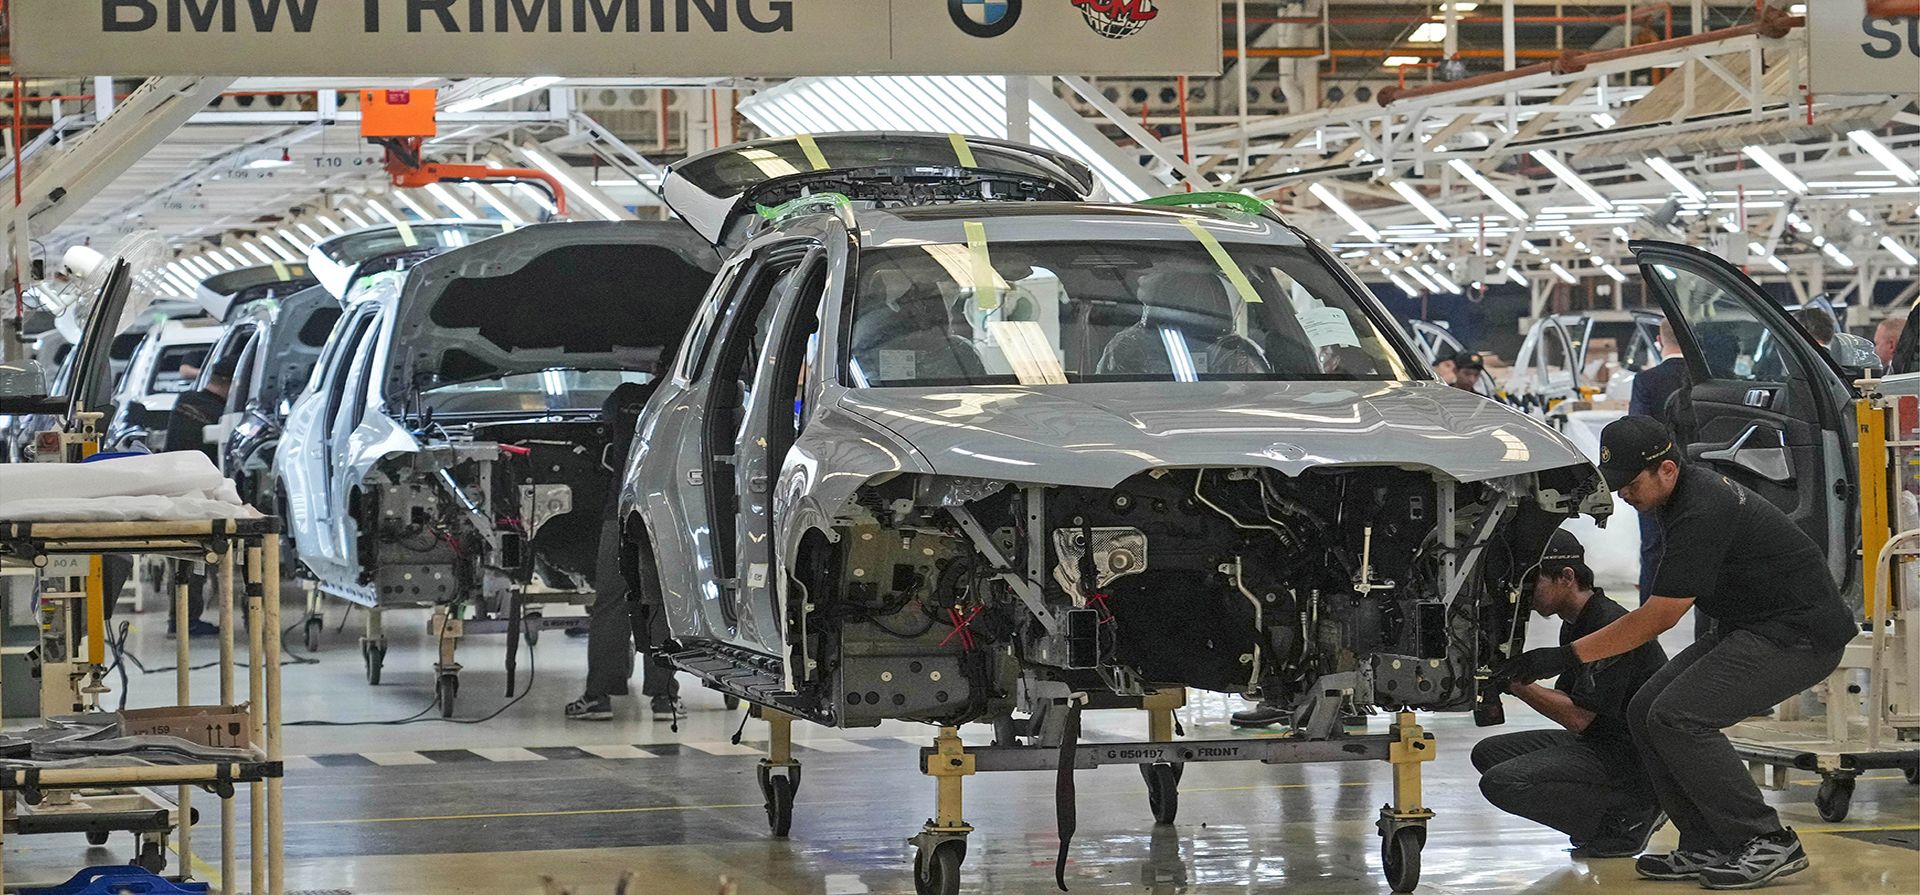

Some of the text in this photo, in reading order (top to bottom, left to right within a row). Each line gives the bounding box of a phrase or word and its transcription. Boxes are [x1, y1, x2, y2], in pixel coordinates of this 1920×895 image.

[102, 0, 319, 33] BMW
[1860, 14, 1920, 59] S
[313, 156, 342, 168] T.10
[151, 725, 170, 735] 159
[1107, 750, 1117, 759] G
[1197, 747, 1239, 757] FRONT
